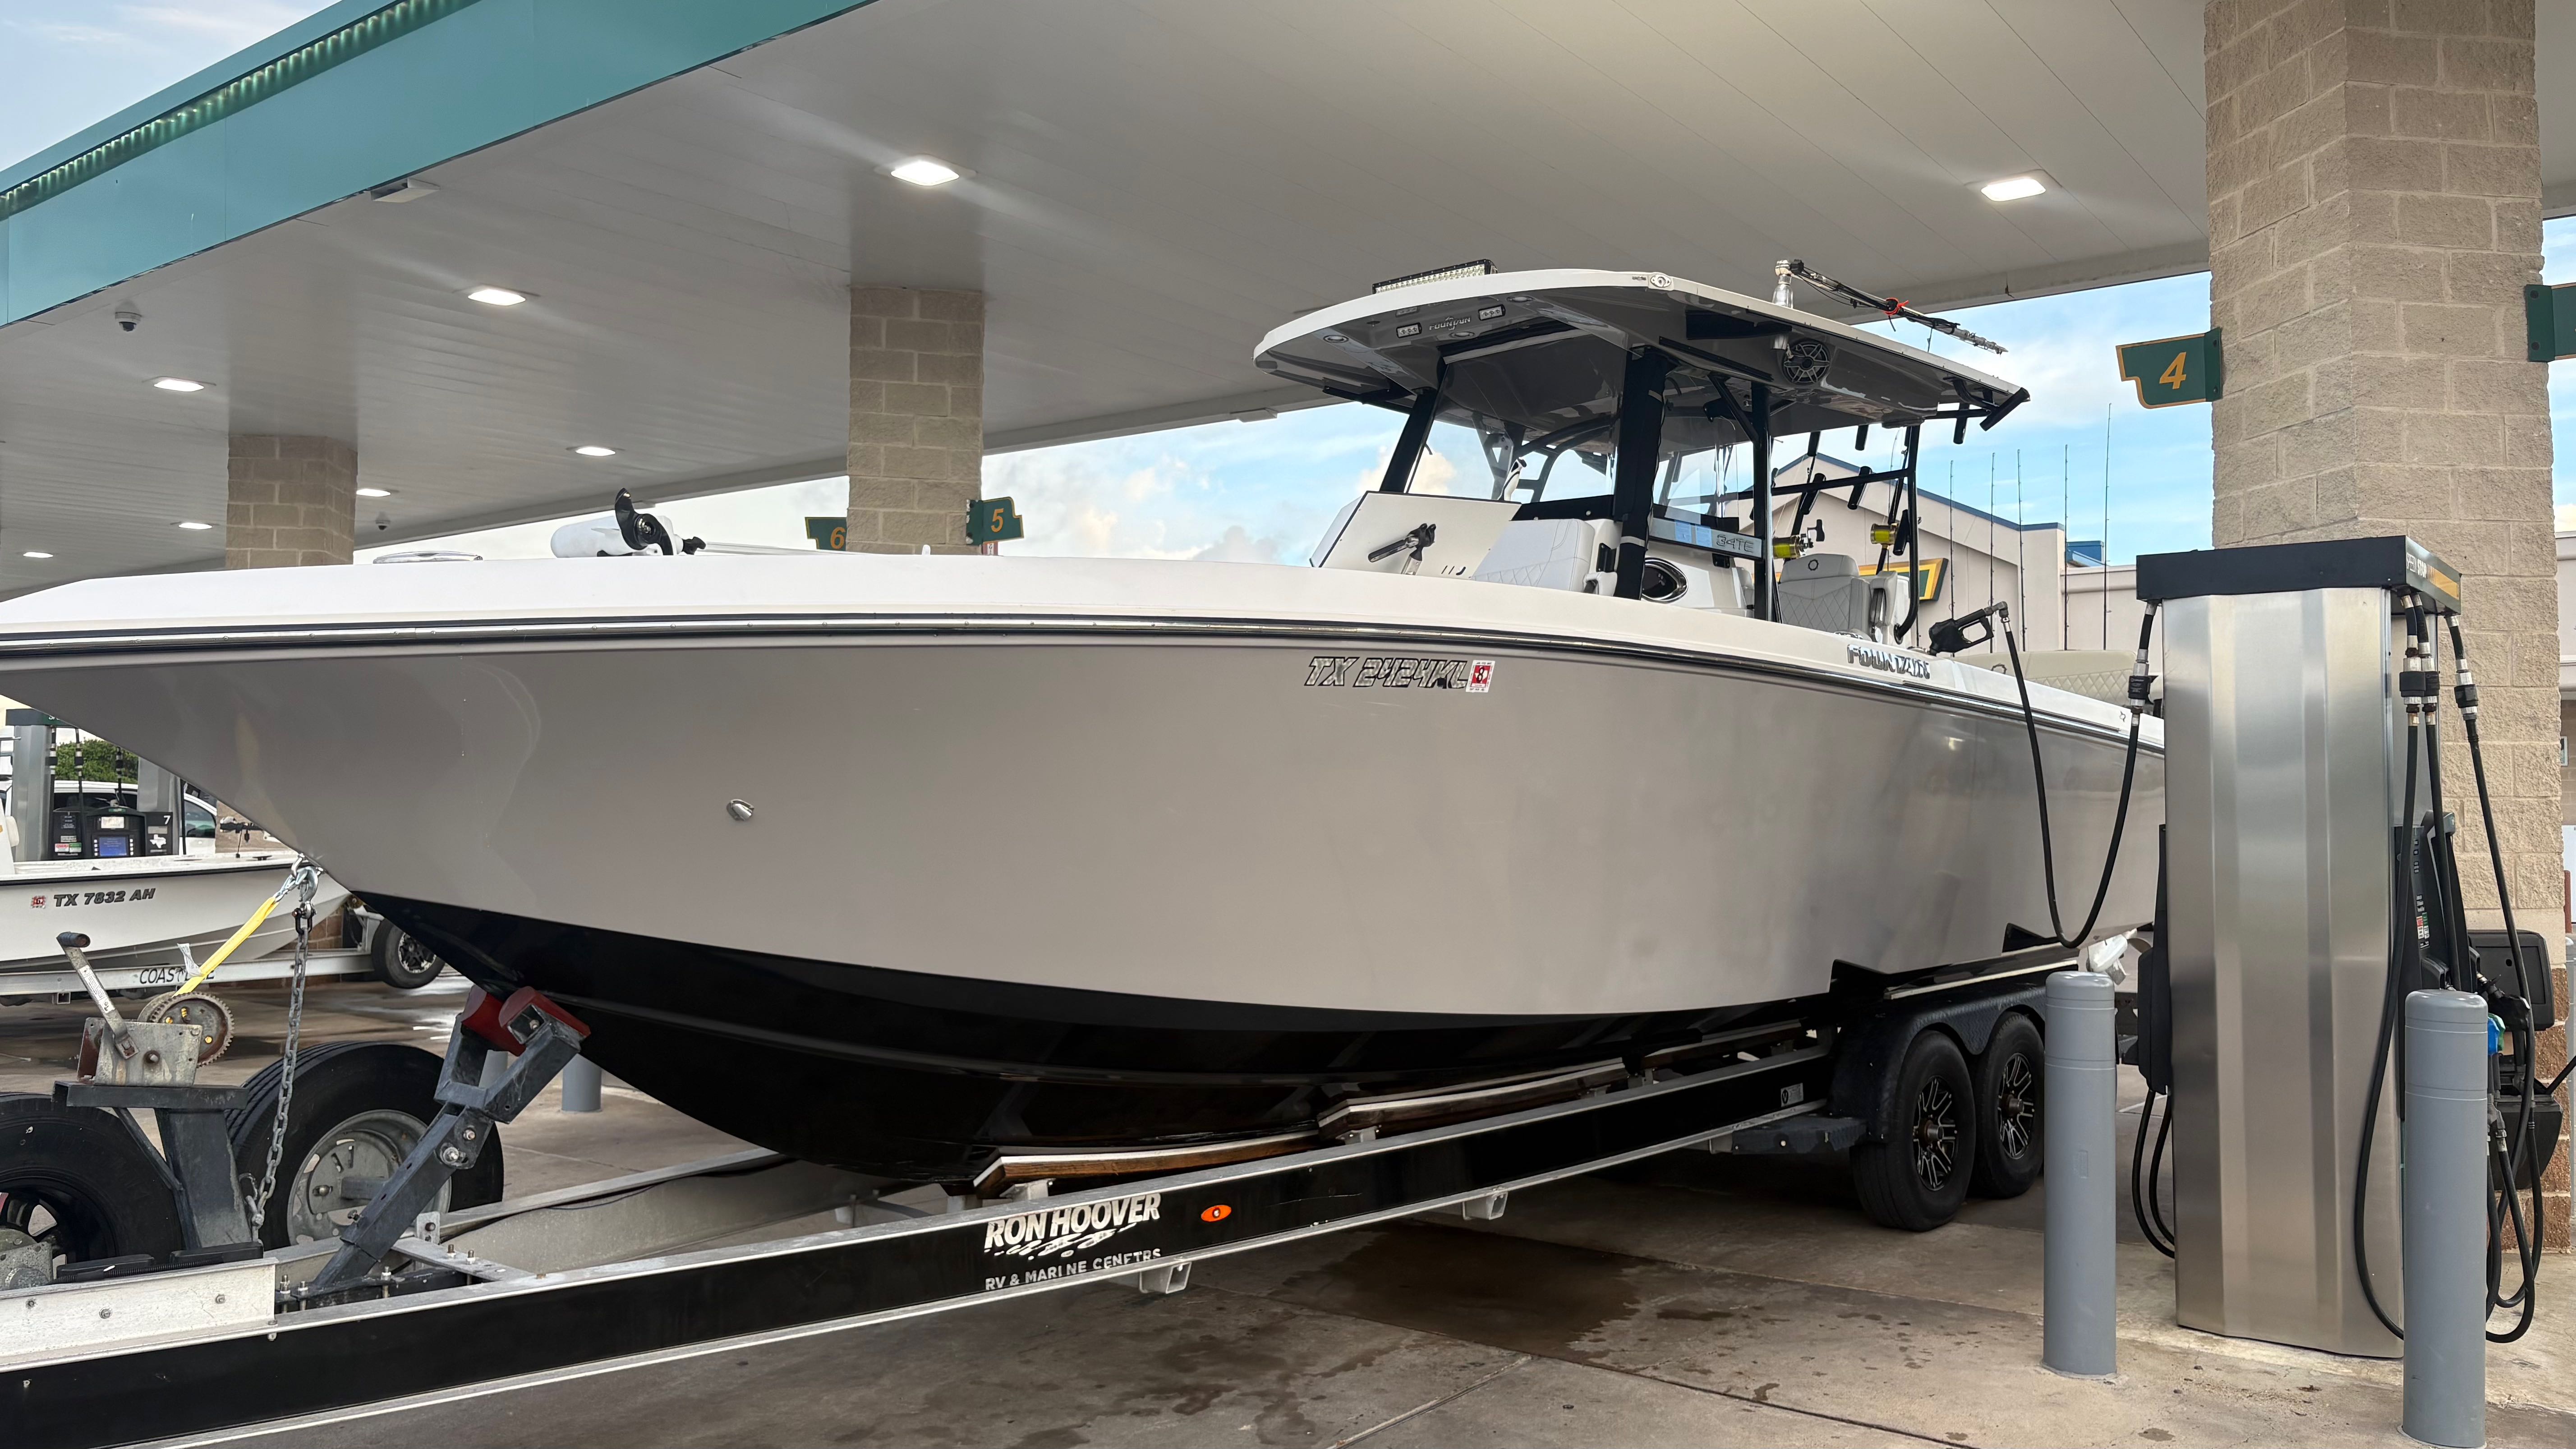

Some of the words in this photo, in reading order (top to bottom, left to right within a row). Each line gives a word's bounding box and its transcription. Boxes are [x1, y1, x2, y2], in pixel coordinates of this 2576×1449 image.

[2159, 352, 2186, 390] 4
[991, 508, 1004, 533] 5
[830, 527, 846, 549] 6
[1716, 534, 1754, 553] 34TE
[1304, 656, 1360, 686] TX
[1352, 658, 1468, 690] 2424KL
[1846, 644, 1931, 680] FOUNTAIN
[1477, 667, 1485, 684] 8
[163, 815, 171, 825] 7
[53, 893, 79, 907] TX
[84, 890, 126, 905] 7832
[129, 888, 156, 902] AH
[984, 1212, 1047, 1249] RON
[1049, 1193, 1161, 1237] HOOVER
[985, 1276, 1006, 1290] RV
[1010, 1274, 1020, 1285] &
